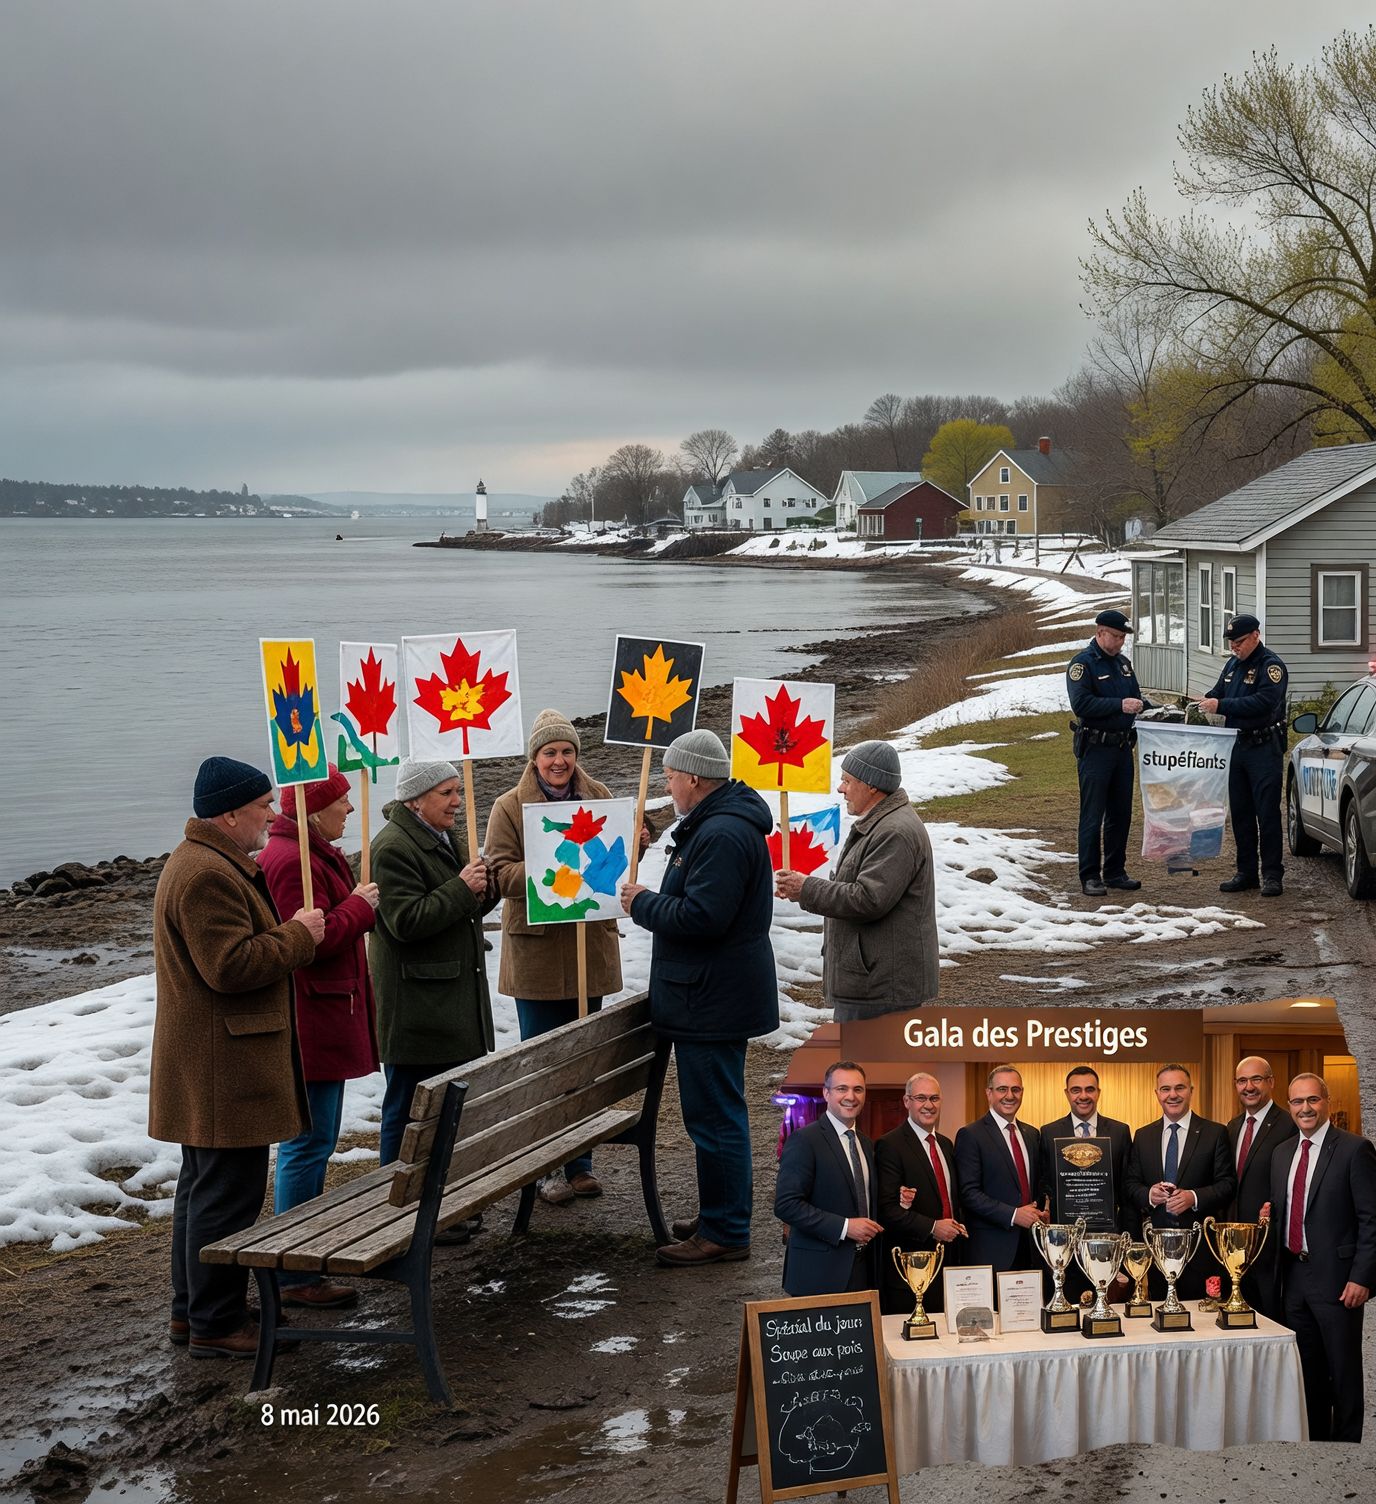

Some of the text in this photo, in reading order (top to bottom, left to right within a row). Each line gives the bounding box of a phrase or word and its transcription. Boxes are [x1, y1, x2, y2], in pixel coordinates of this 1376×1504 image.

[1142, 750, 1227, 771] stupéfiants
[903, 1018, 1148, 1055] Gala des Prestiges
[815, 1315, 832, 1332] du
[812, 1347, 834, 1358] aux
